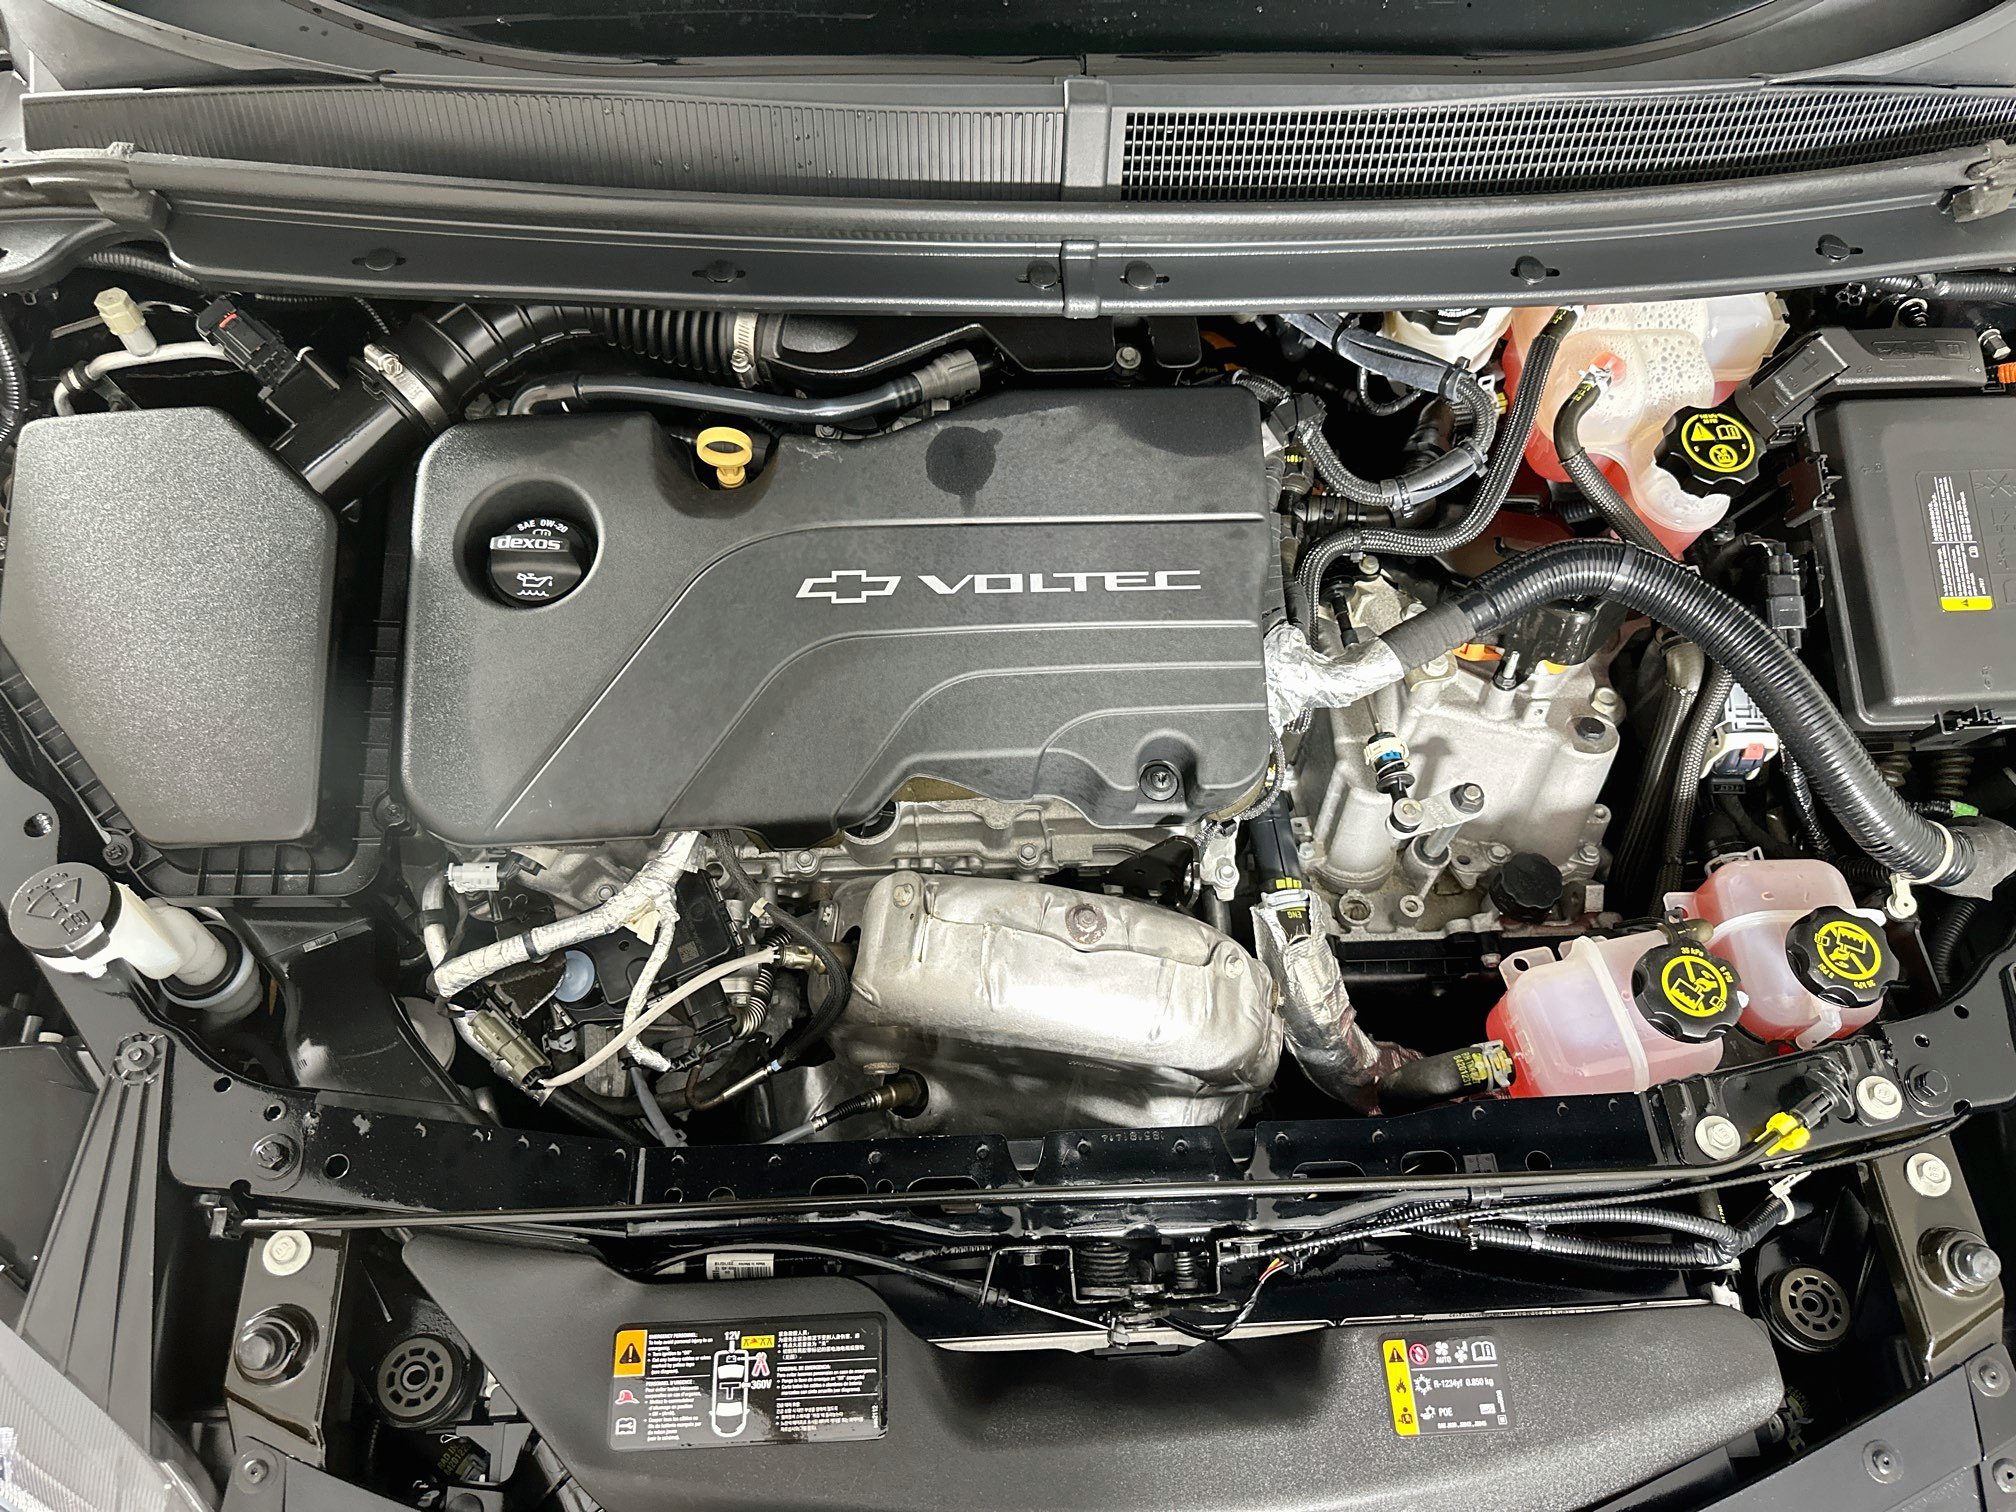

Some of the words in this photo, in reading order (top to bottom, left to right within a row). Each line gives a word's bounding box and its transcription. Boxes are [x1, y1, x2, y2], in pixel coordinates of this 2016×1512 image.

[517, 520, 535, 531] SAE
[540, 519, 568, 533] 0W-20
[497, 535, 563, 550] dexos
[917, 570, 1201, 595] VOLTEC
[724, 1331, 740, 1340] 12V
[1436, 1356, 1451, 1364] AUTO
[751, 1379, 772, 1389] 360V
[1433, 1378, 1463, 1389] R-1234yf
[1465, 1377, 1484, 1386] 0.850
[1484, 1377, 1494, 1388] kg
[1439, 1407, 1453, 1417] POE
